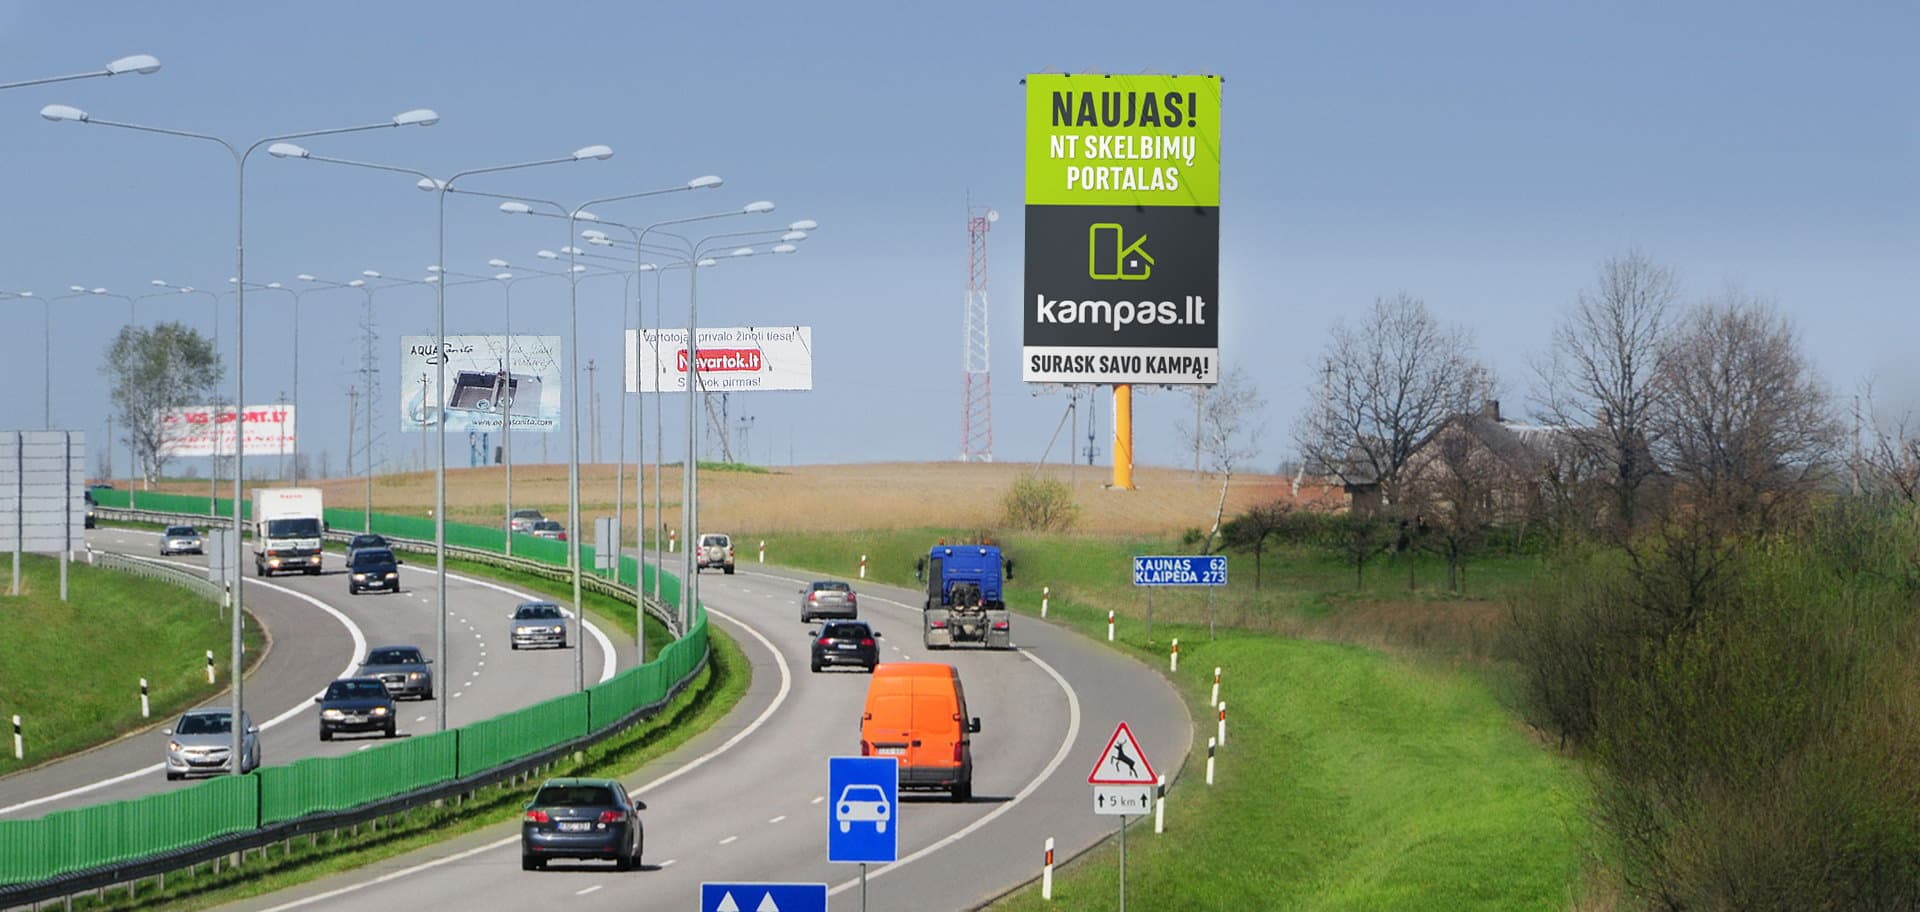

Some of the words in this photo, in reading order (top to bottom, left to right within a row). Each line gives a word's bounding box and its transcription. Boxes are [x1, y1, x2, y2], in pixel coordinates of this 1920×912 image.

[1051, 91, 1197, 128] NAUJAS!
[1050, 135, 1079, 159] NT
[1084, 135, 1196, 167] SKELBIMŲ
[1067, 166, 1179, 191] PORTALAS
[1036, 294, 1205, 332] kampas.lt
[699, 331, 733, 344] privalo
[1031, 355, 1095, 375] SURASK
[1099, 355, 1141, 375] SAVO
[1145, 356, 1209, 379] KAMPĄ!
[1135, 559, 1191, 571] KAUNAS
[1209, 559, 1225, 571] 62
[1135, 570, 1198, 583] KLAIPĖDA
[1202, 571, 1225, 583] 273
[1110, 795, 1117, 807] 5
[1121, 796, 1136, 807] km
